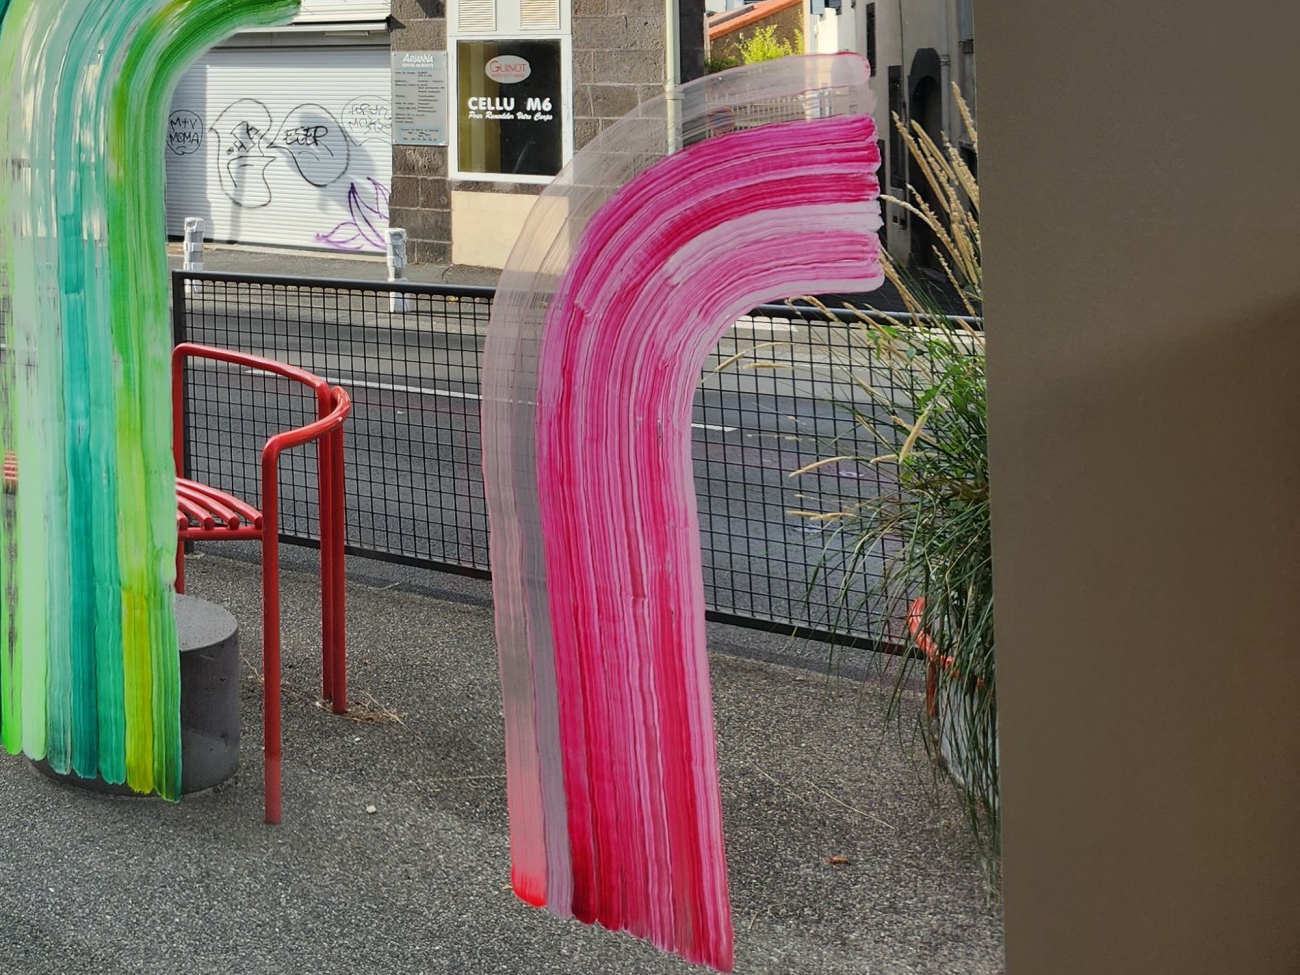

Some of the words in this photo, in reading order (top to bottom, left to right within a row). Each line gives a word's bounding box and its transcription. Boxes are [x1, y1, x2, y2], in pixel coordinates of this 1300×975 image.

[490, 60, 527, 73] GUINOT
[467, 96, 515, 111] CELLU
[526, 97, 553, 112] M6
[533, 111, 553, 121] Corps
[169, 131, 200, 145] MOMA
